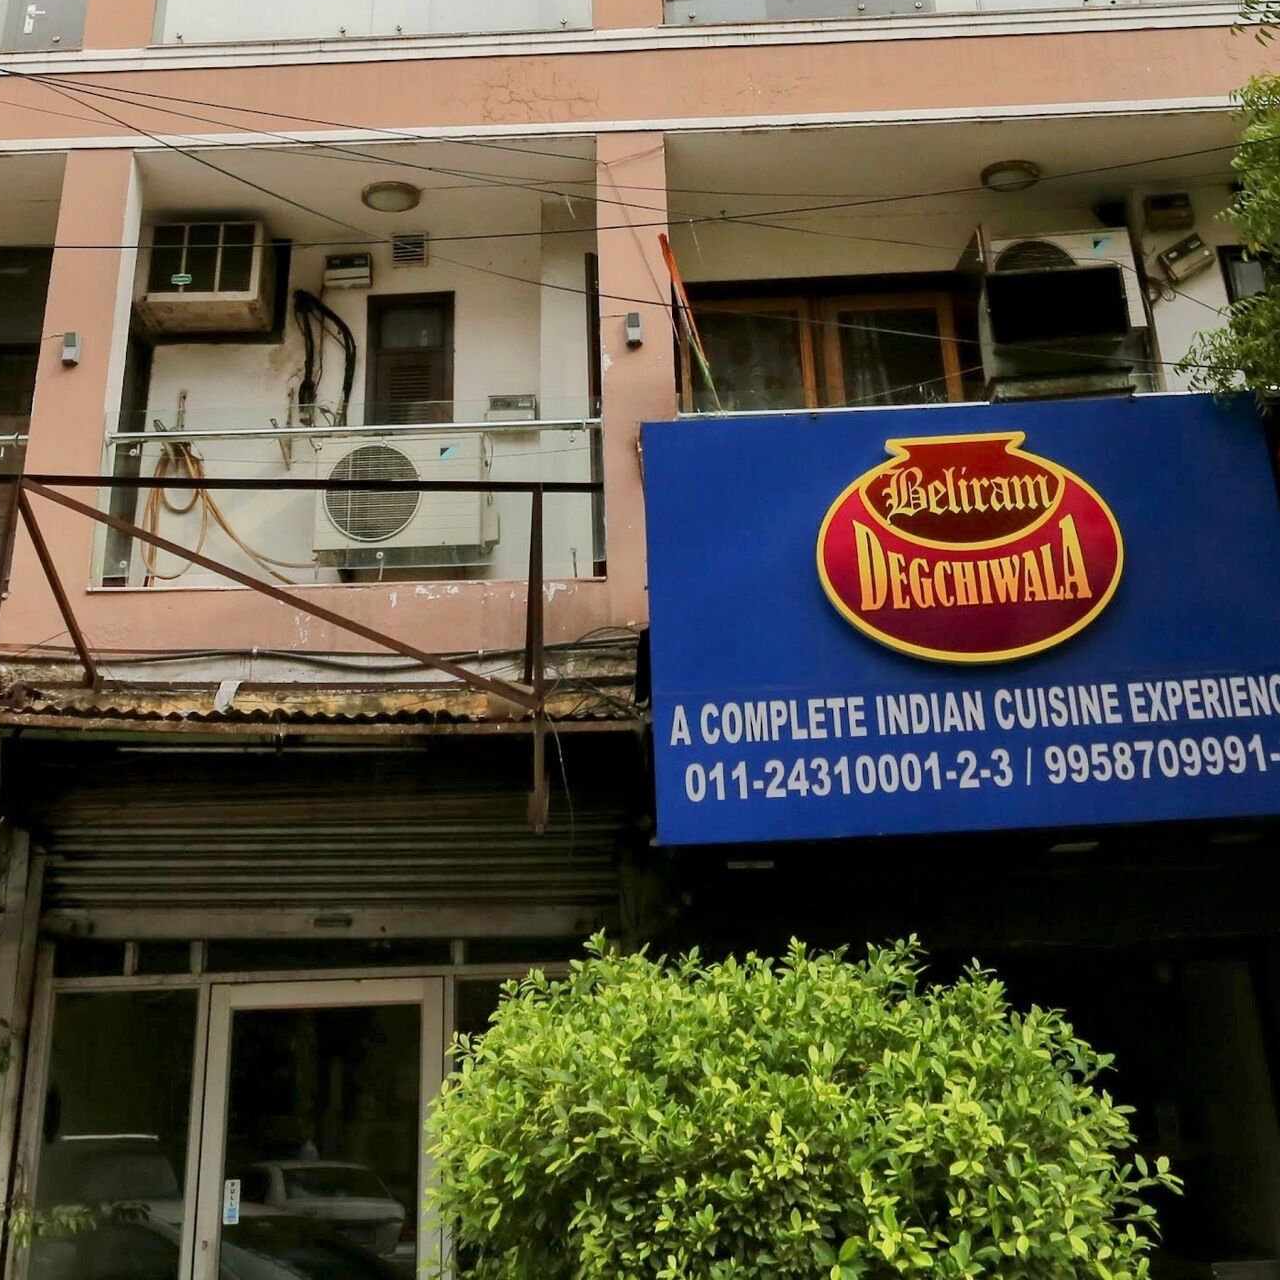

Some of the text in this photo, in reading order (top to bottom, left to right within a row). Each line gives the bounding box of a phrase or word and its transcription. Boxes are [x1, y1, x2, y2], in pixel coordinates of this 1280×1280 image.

[879, 465, 1057, 524] Beliram
[852, 513, 1093, 613] DEGCHIWALA
[670, 704, 692, 748] A
[700, 695, 866, 744] COMPLETE
[876, 689, 986, 737] INDIAN
[994, 682, 1123, 731] CUISINE
[684, 749, 1014, 804] 011-24310001-2-3
